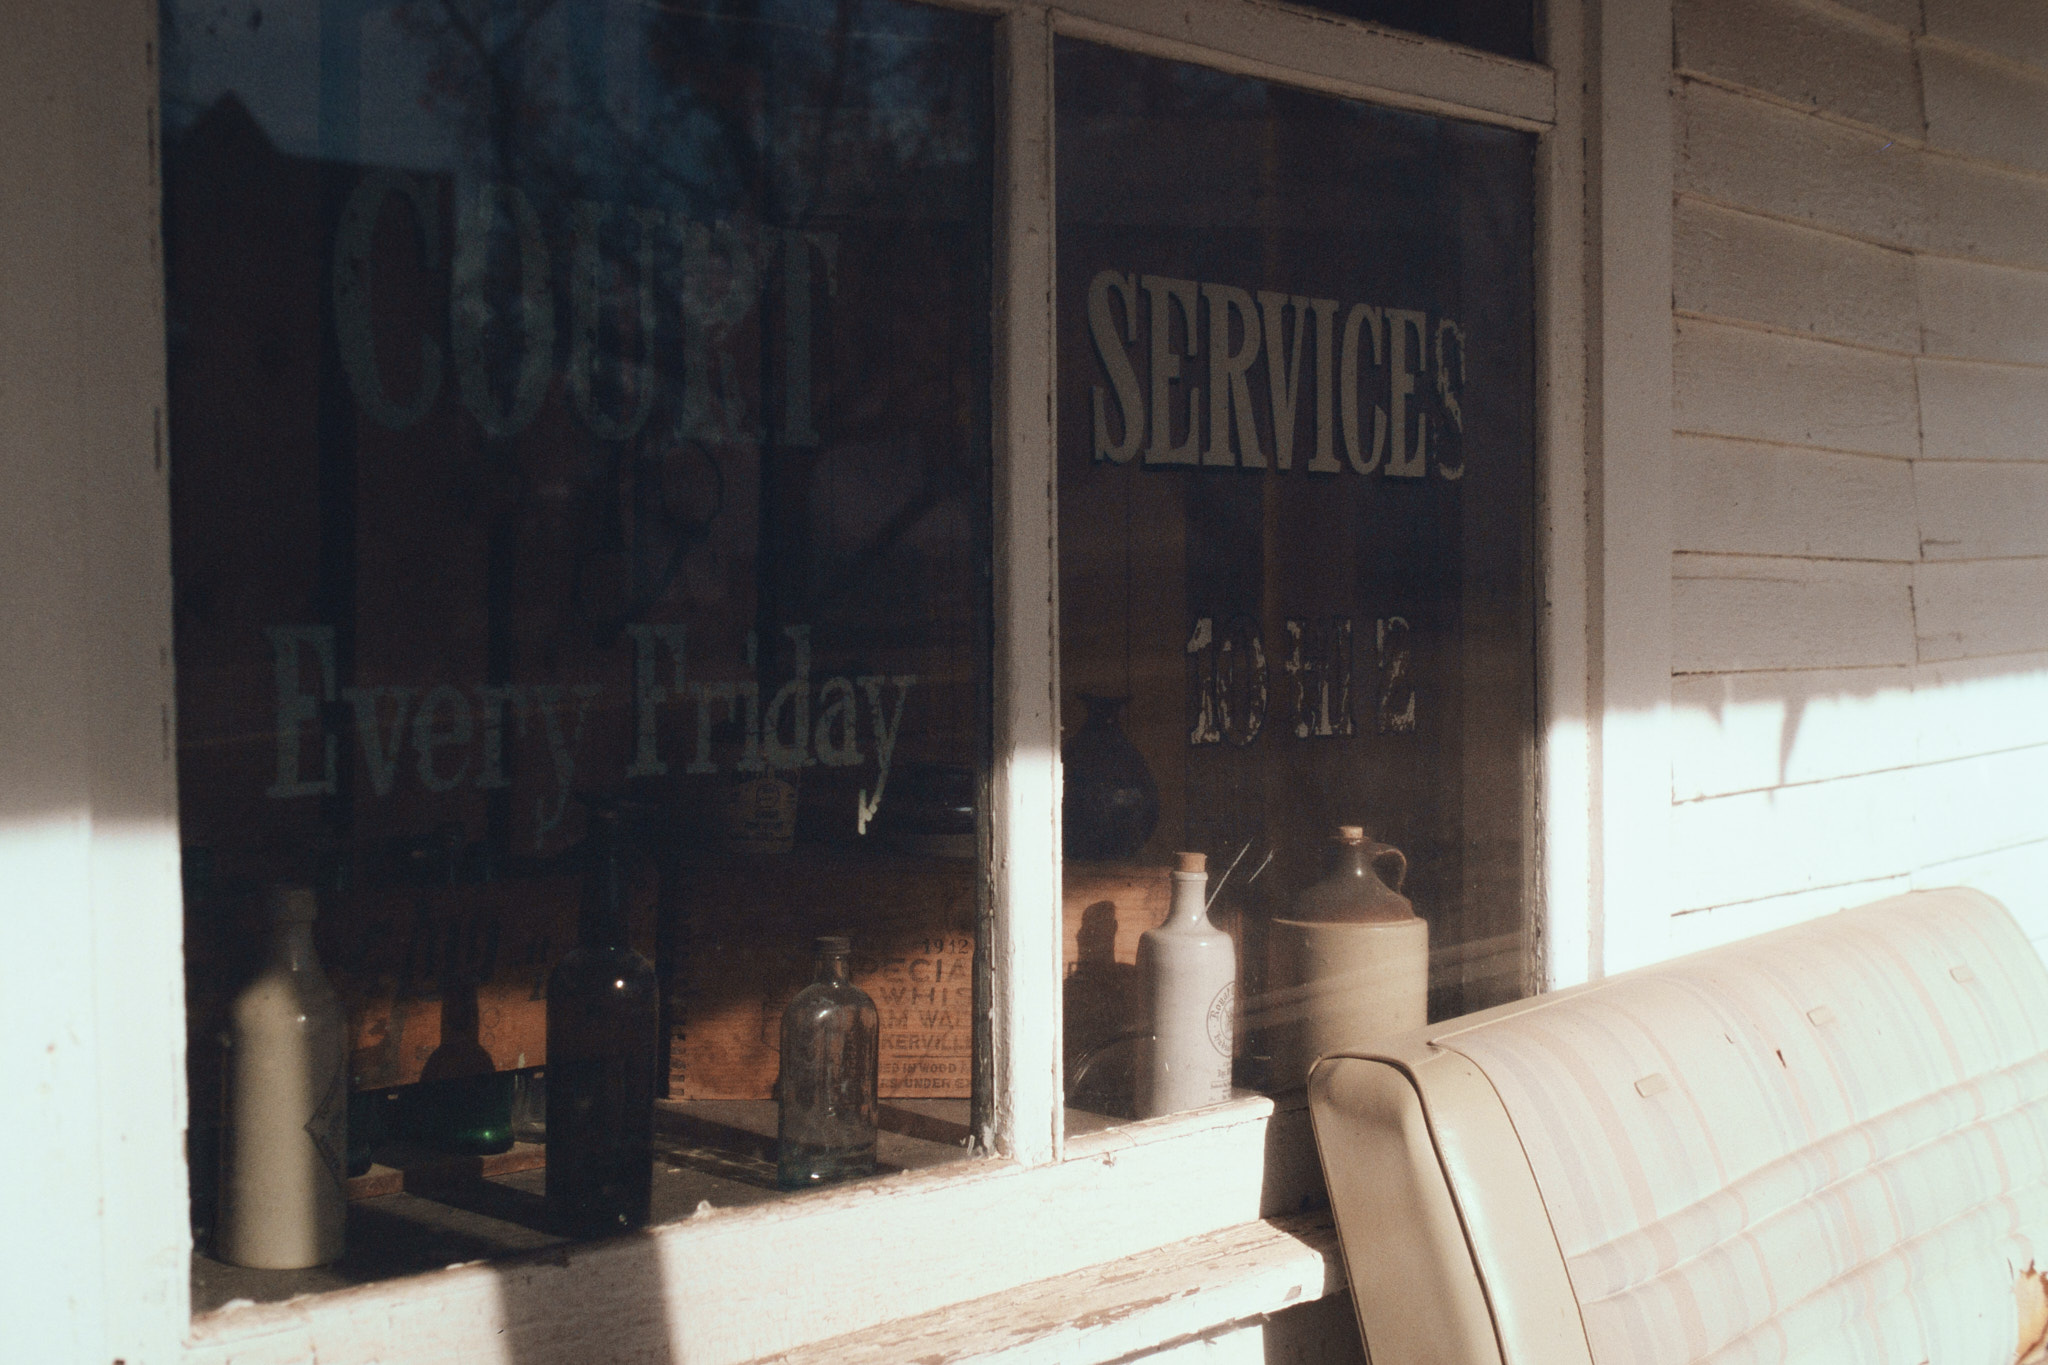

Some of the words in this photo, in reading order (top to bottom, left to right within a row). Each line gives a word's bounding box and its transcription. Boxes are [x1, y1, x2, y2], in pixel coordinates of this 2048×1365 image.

[333, 168, 840, 446] COURT
[1088, 269, 1466, 480] SERVICES
[265, 624, 604, 850] Every
[626, 622, 917, 837] Friday
